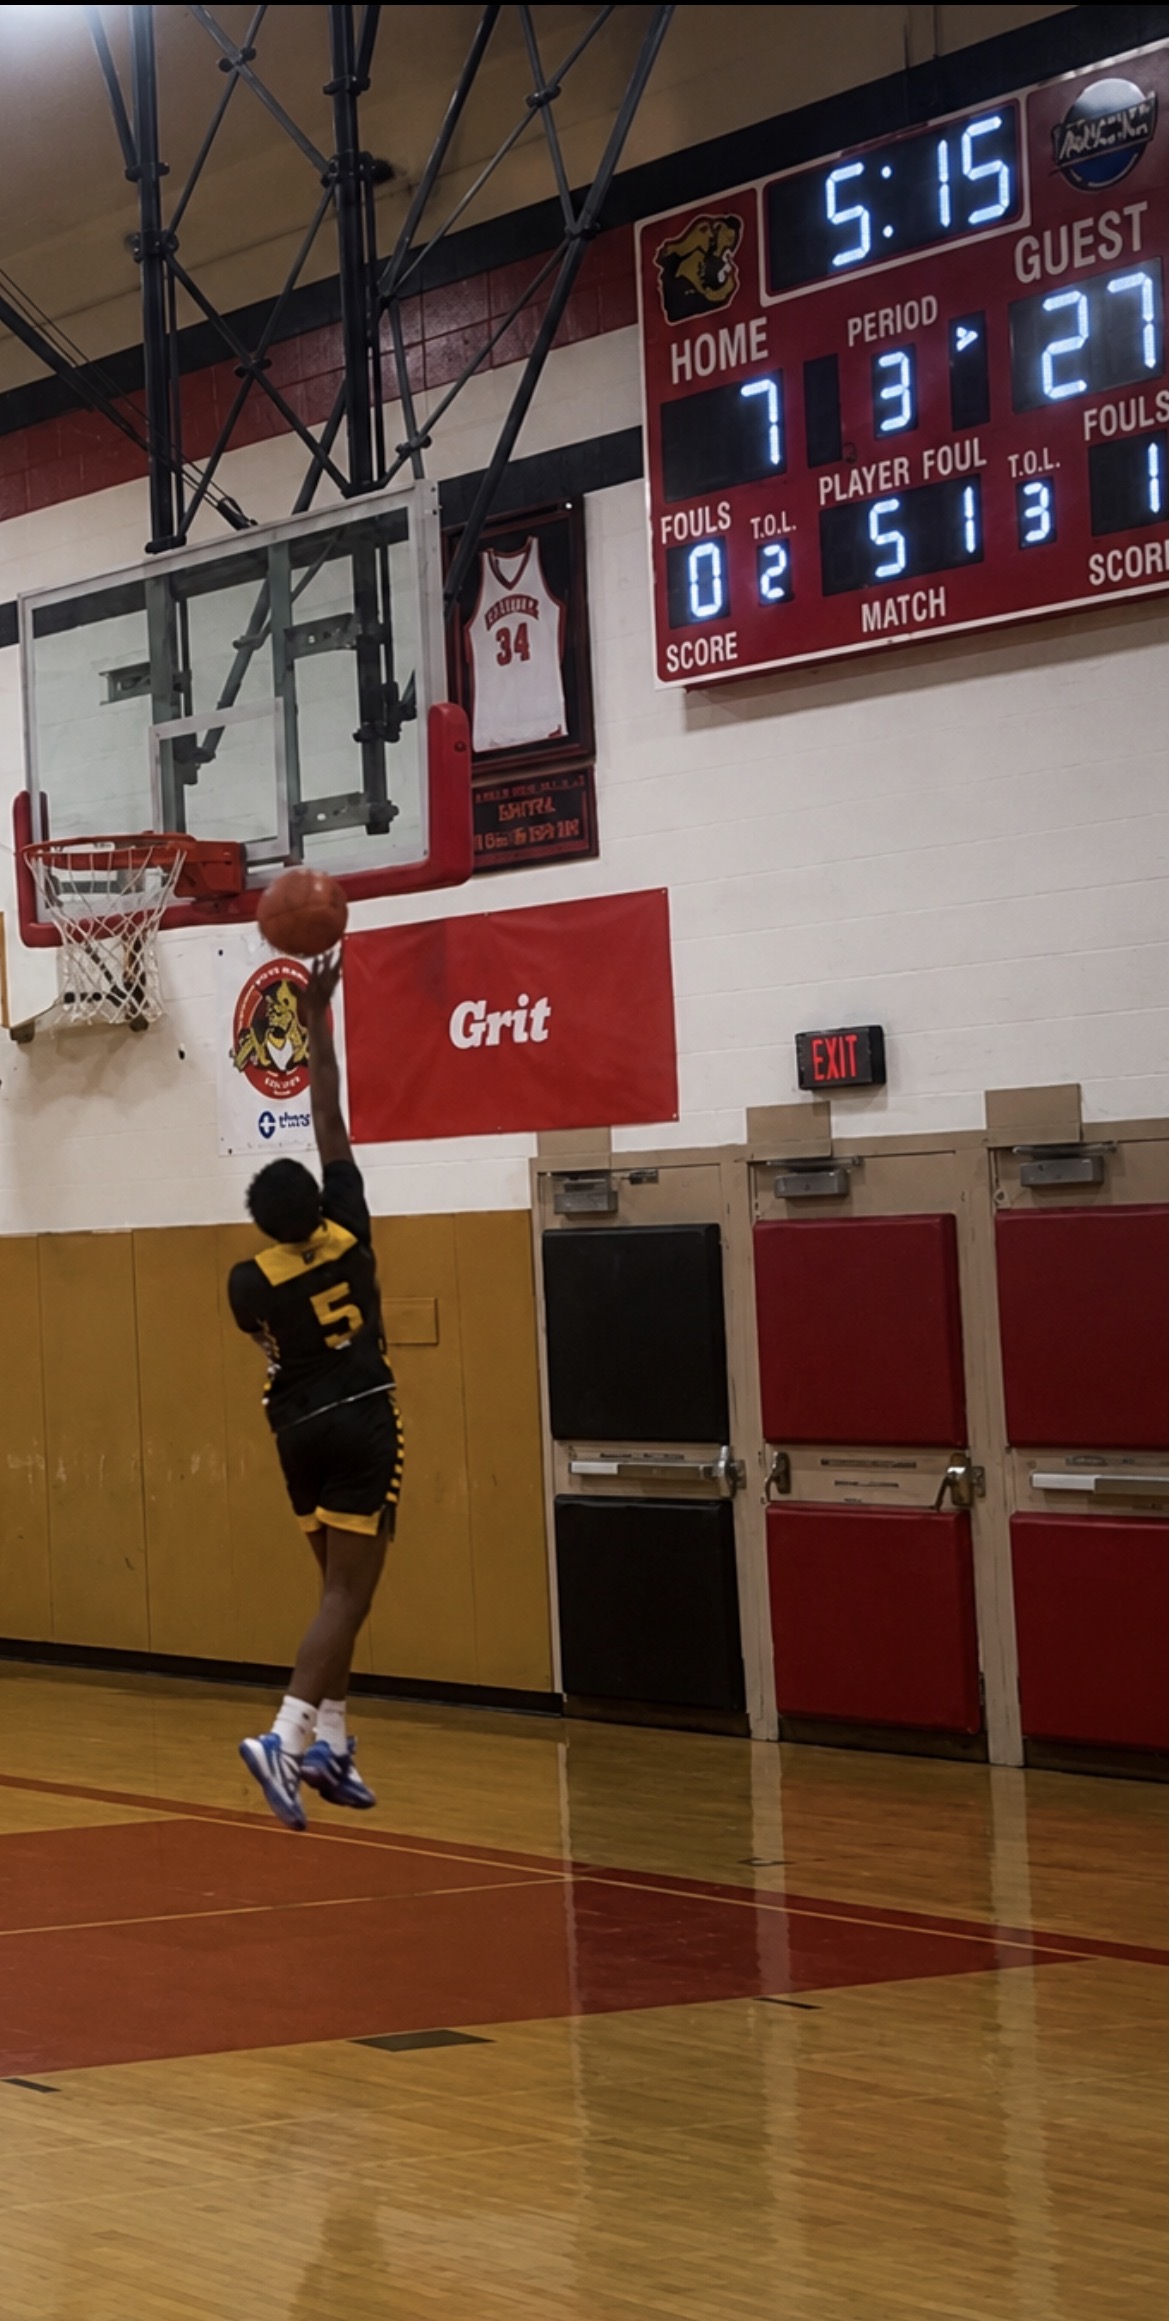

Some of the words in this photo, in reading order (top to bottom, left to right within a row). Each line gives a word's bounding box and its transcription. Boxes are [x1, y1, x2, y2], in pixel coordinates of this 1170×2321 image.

[826, 116, 1009, 267] 5:15
[1014, 202, 1149, 283] GUEST
[847, 296, 938, 347] PERIOD
[1041, 272, 1157, 400] 27
[670, 317, 768, 384] HOME
[878, 351, 912, 432] 3
[1084, 390, 1169, 441] FOULS
[741, 379, 781, 464] 7
[819, 457, 909, 505] PLAYER
[923, 437, 987, 479] FOUL
[1009, 448, 1060, 477] T.O.L.
[1147, 443, 1160, 513] 1
[661, 502, 731, 544] FOULS
[751, 512, 797, 539] T.O.L.
[1023, 482, 1051, 542] 3
[688, 541, 722, 619] 0
[760, 544, 788, 600] 2
[1089, 540, 1169, 586] SCOR
[861, 587, 946, 633] MATCH
[496, 623, 530, 666] 34
[666, 632, 738, 673] SCORE
[449, 993, 552, 1050] Grit
[811, 1034, 857, 1081] EXIT
[310, 1282, 363, 1350] 5
